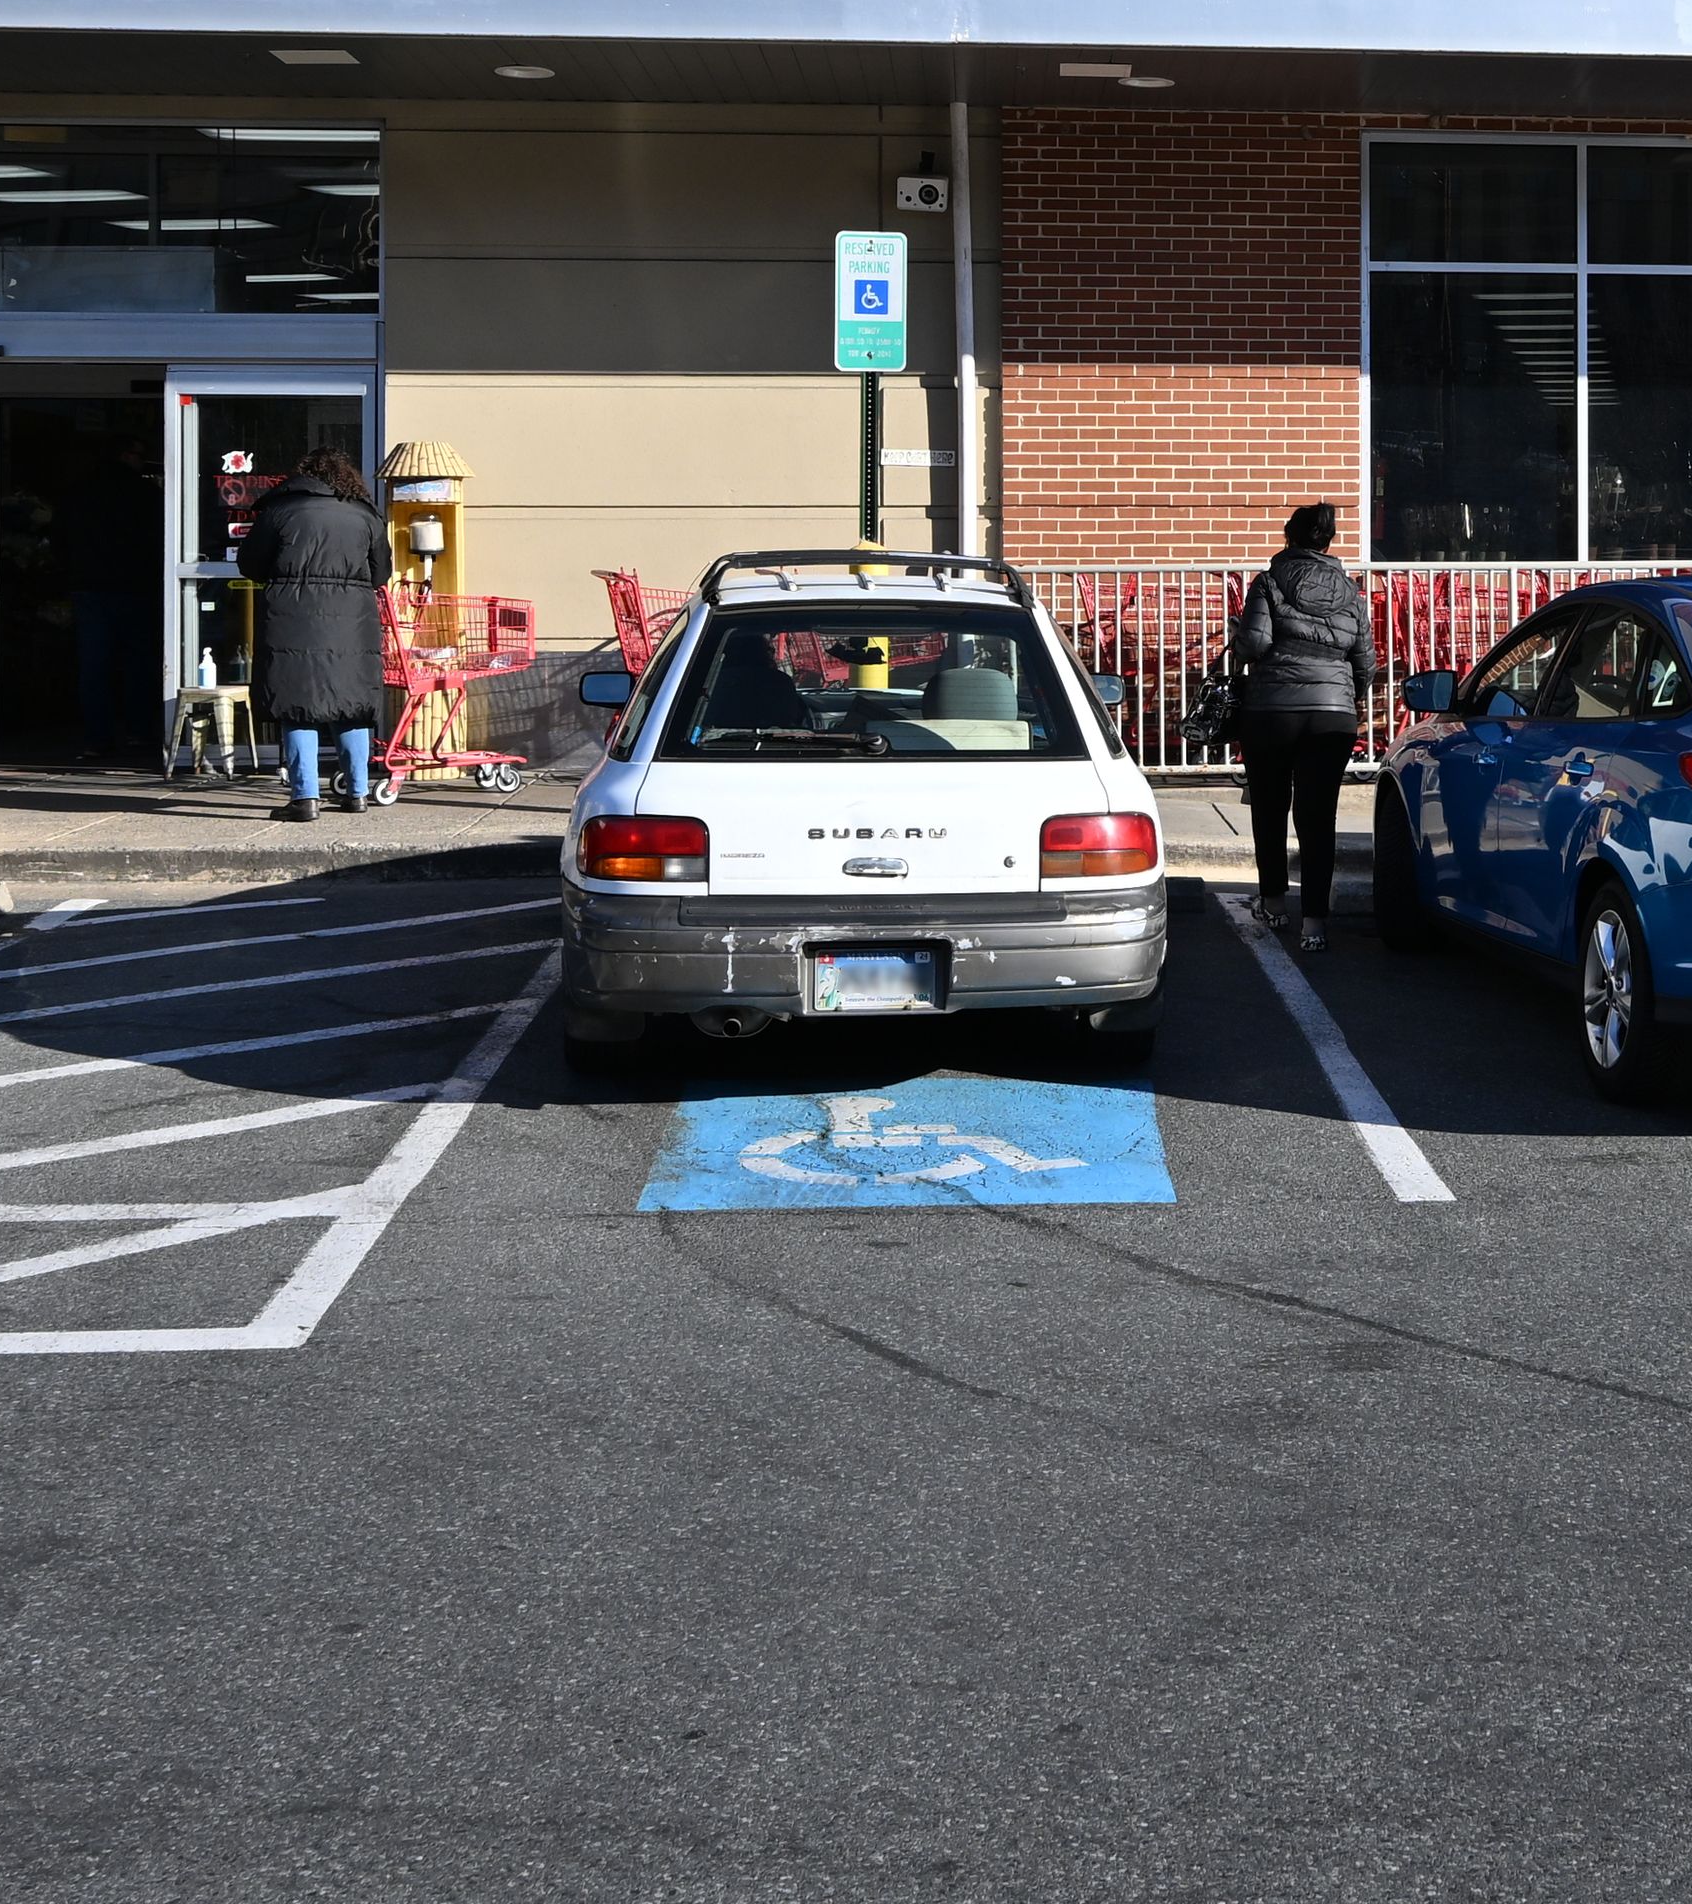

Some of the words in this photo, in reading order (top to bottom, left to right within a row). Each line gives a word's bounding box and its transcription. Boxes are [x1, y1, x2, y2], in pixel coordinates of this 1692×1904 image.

[844, 242, 895, 256] RESERVED
[848, 261, 890, 274] PARKING
[808, 827, 947, 839] SUBARU
